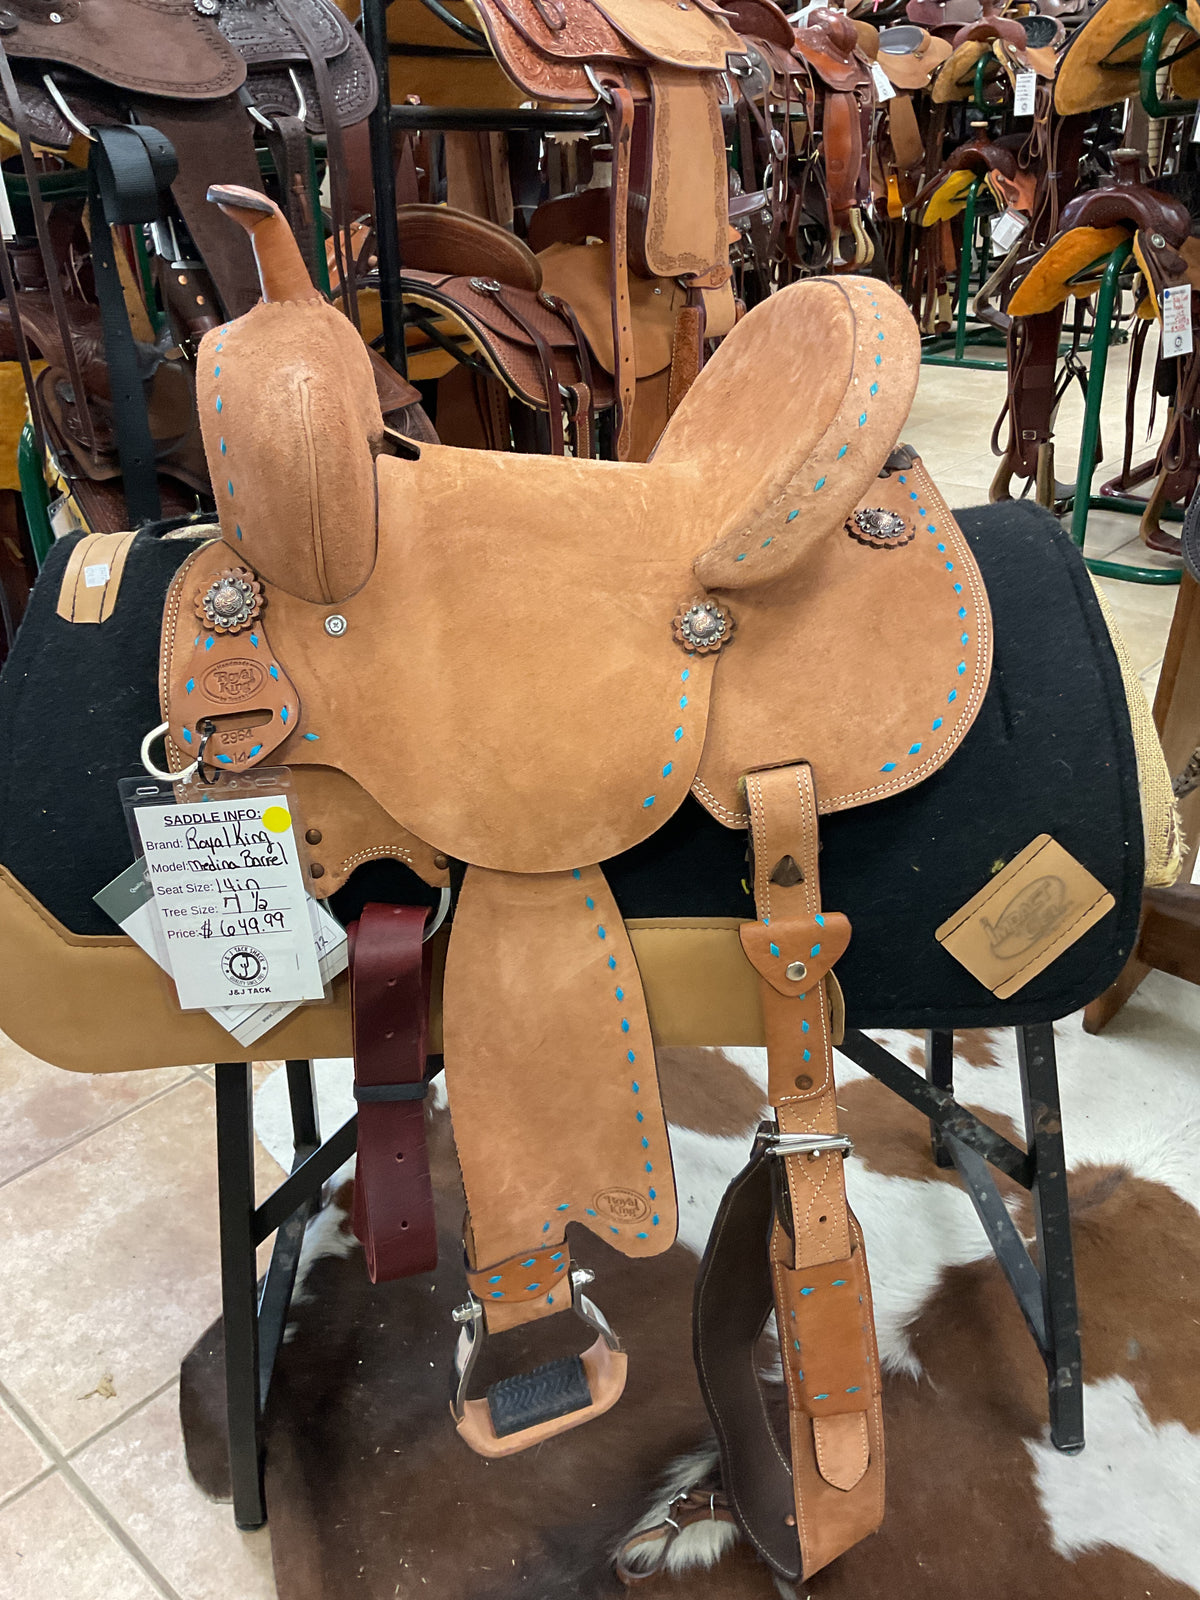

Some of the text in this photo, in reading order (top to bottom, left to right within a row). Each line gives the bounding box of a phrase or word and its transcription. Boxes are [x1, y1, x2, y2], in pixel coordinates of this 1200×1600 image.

[213, 668, 255, 684] Royal
[219, 682, 251, 695] King
[164, 809, 261, 826] SADDLE INFO:
[146, 821, 275, 855] Brand: Royal King
[151, 861, 188, 873] Model:
[240, 842, 288, 868] Barrel
[157, 885, 183, 895] Seat
[186, 882, 214, 893] Size:
[162, 908, 188, 917] Tree
[190, 904, 218, 915] Size:
[167, 929, 199, 940] Price:
[248, 986, 271, 994] TACK
